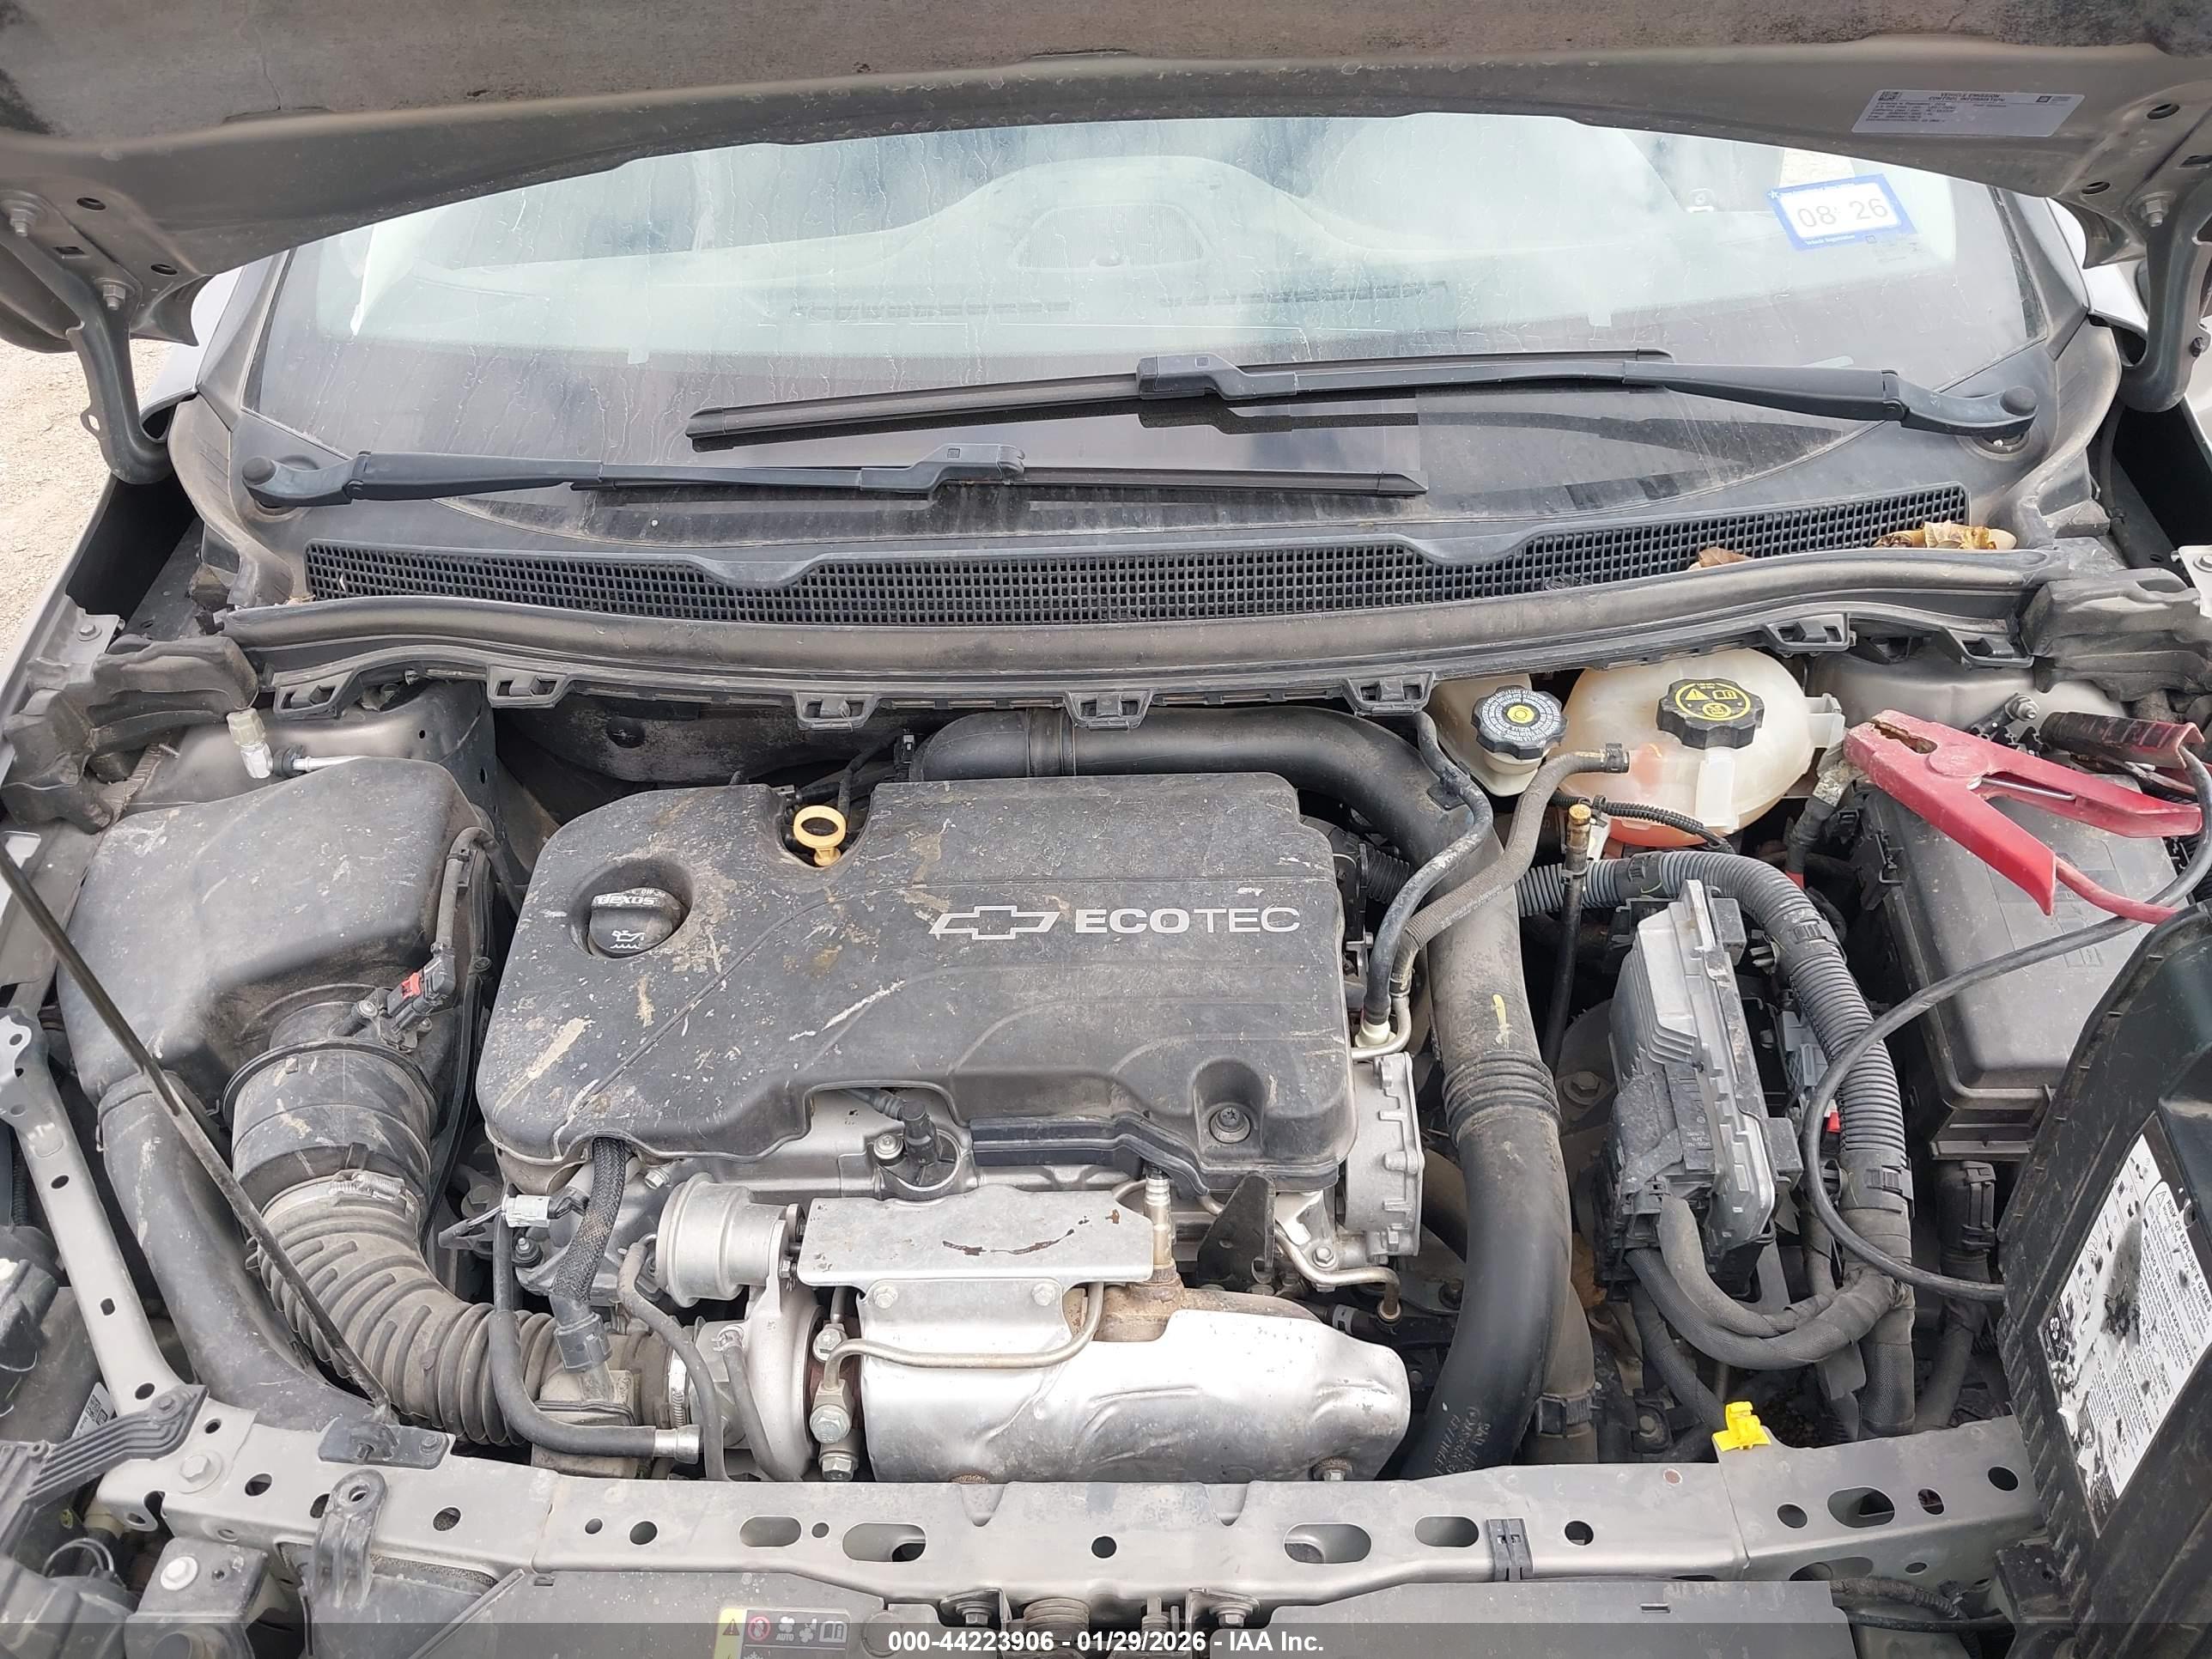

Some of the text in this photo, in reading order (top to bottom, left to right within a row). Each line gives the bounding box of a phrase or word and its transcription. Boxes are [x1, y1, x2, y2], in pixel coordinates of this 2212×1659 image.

[1798, 198, 1887, 228] 08 26
[1075, 907, 1301, 933] ECOTEC
[2143, 1235, 2156, 1267] RIEO
[776, 1633, 794, 1642] AUTO
